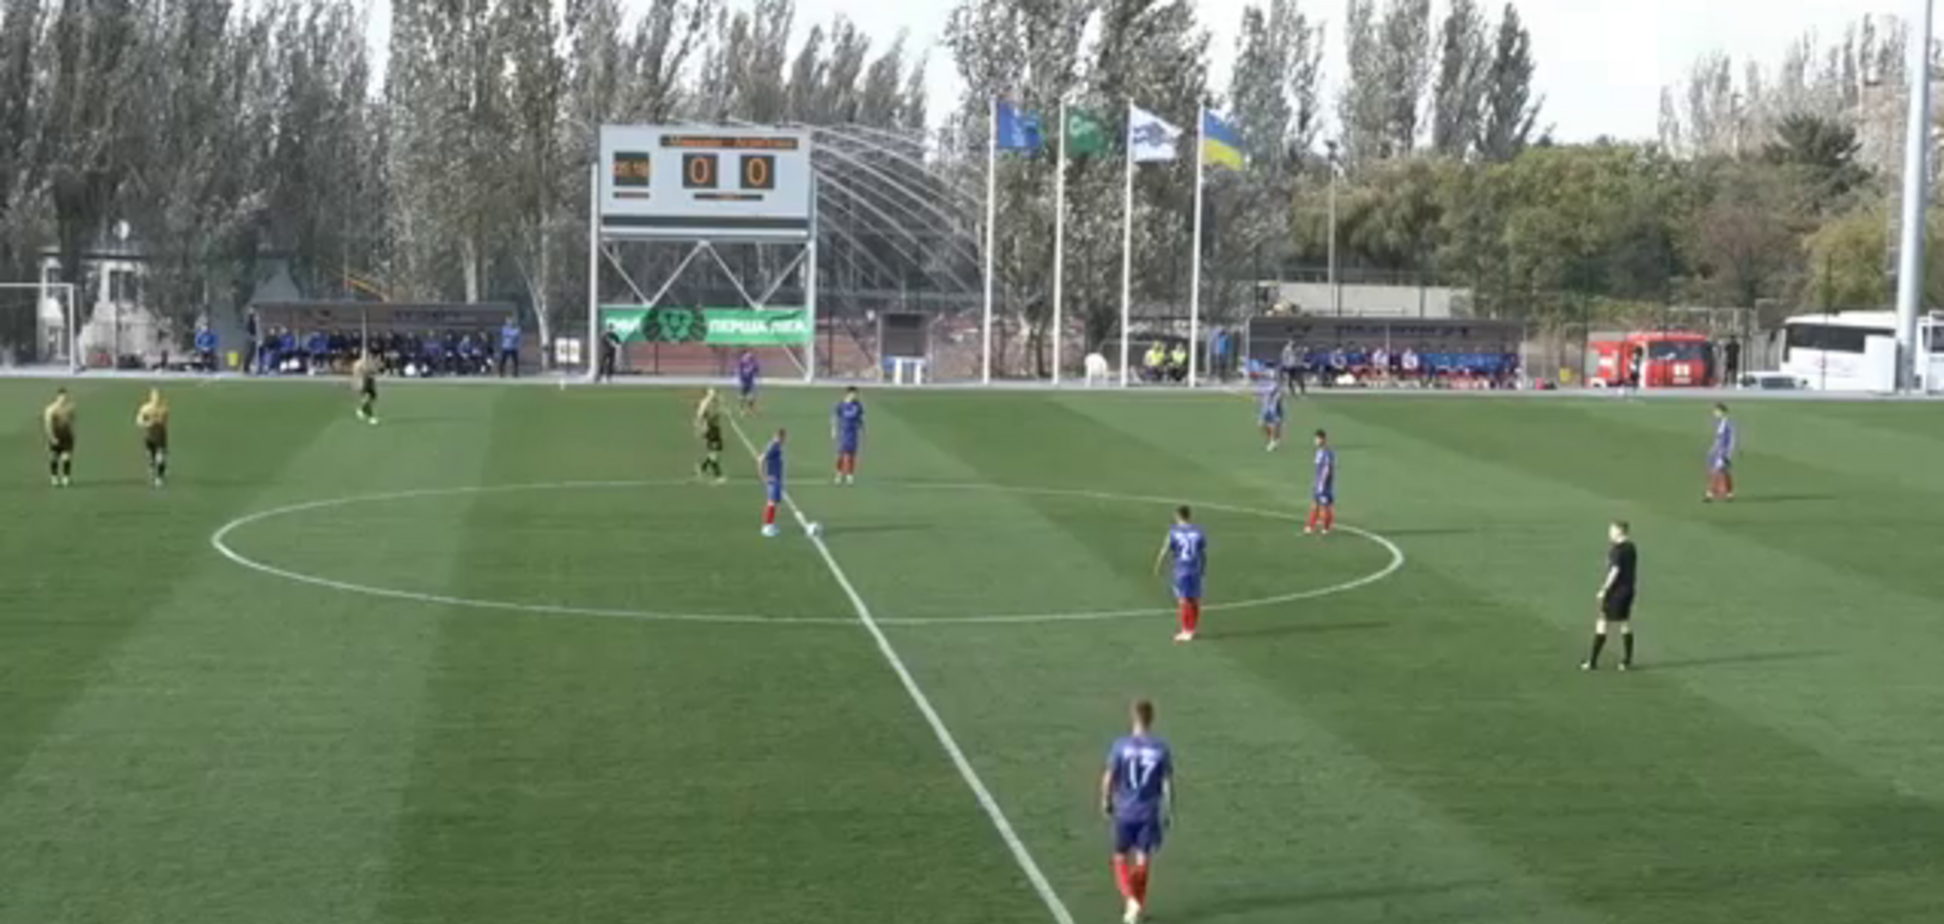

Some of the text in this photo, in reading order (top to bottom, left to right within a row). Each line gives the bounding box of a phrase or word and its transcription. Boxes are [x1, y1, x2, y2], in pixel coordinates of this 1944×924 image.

[690, 157, 767, 185] 0 0
[709, 318, 767, 335] ПЕРША
[1128, 756, 1158, 789] 17
